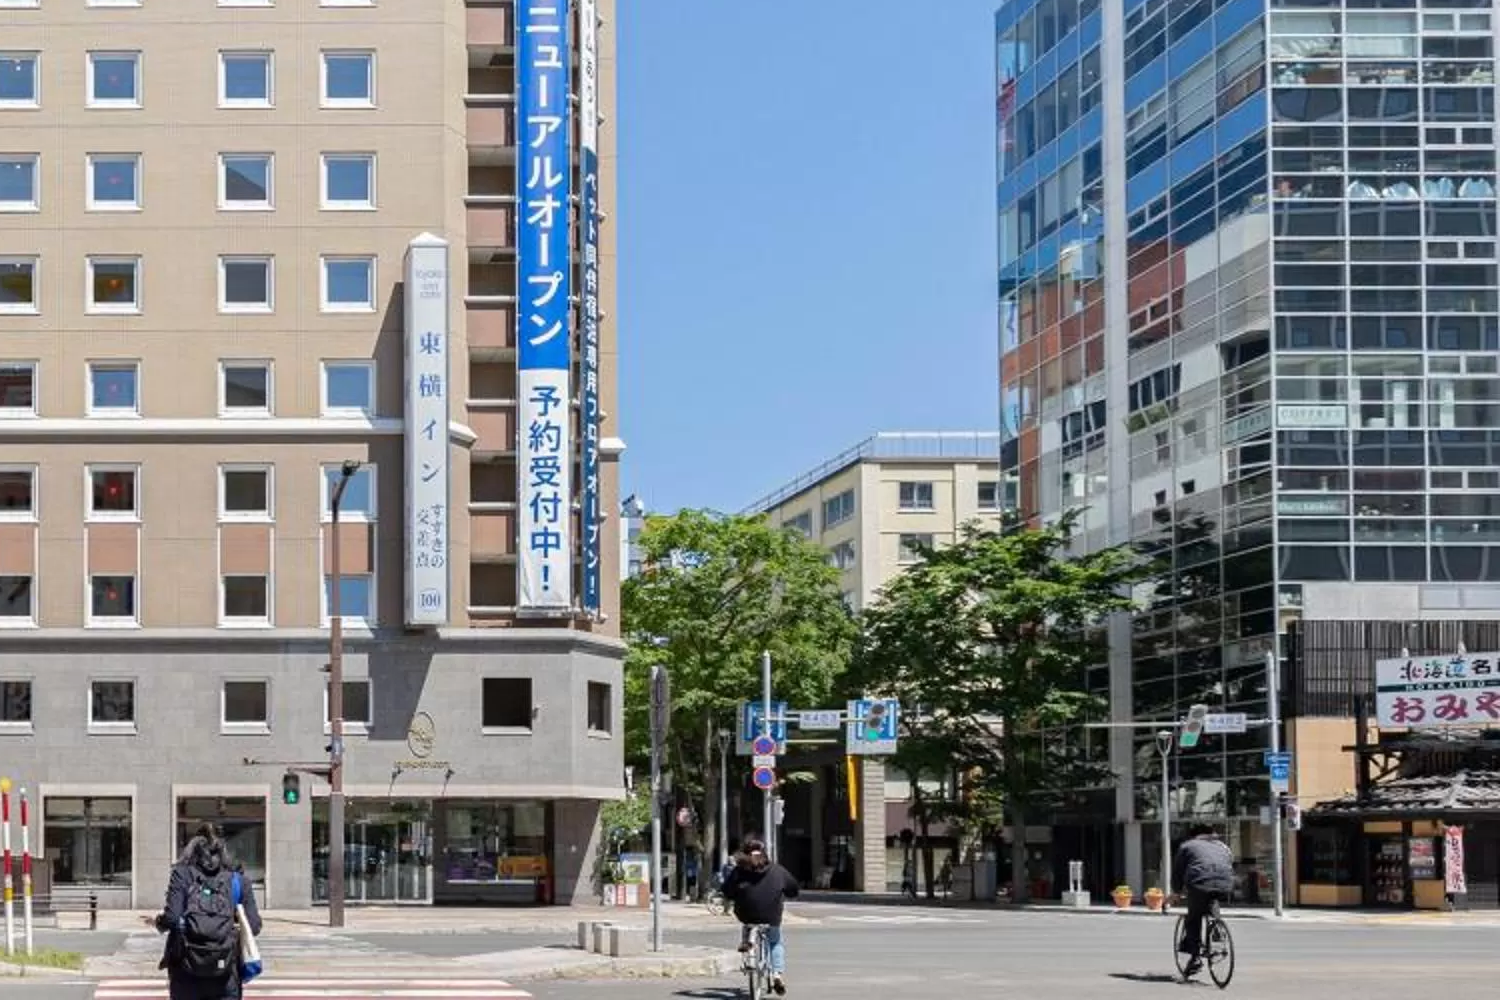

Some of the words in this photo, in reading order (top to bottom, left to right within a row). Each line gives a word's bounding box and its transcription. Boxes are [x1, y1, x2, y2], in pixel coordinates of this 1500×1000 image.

[418, 331, 442, 483] 東横イン
[529, 386, 563, 592] 予約受付中!
[1400, 656, 1500, 681] 北海道名
